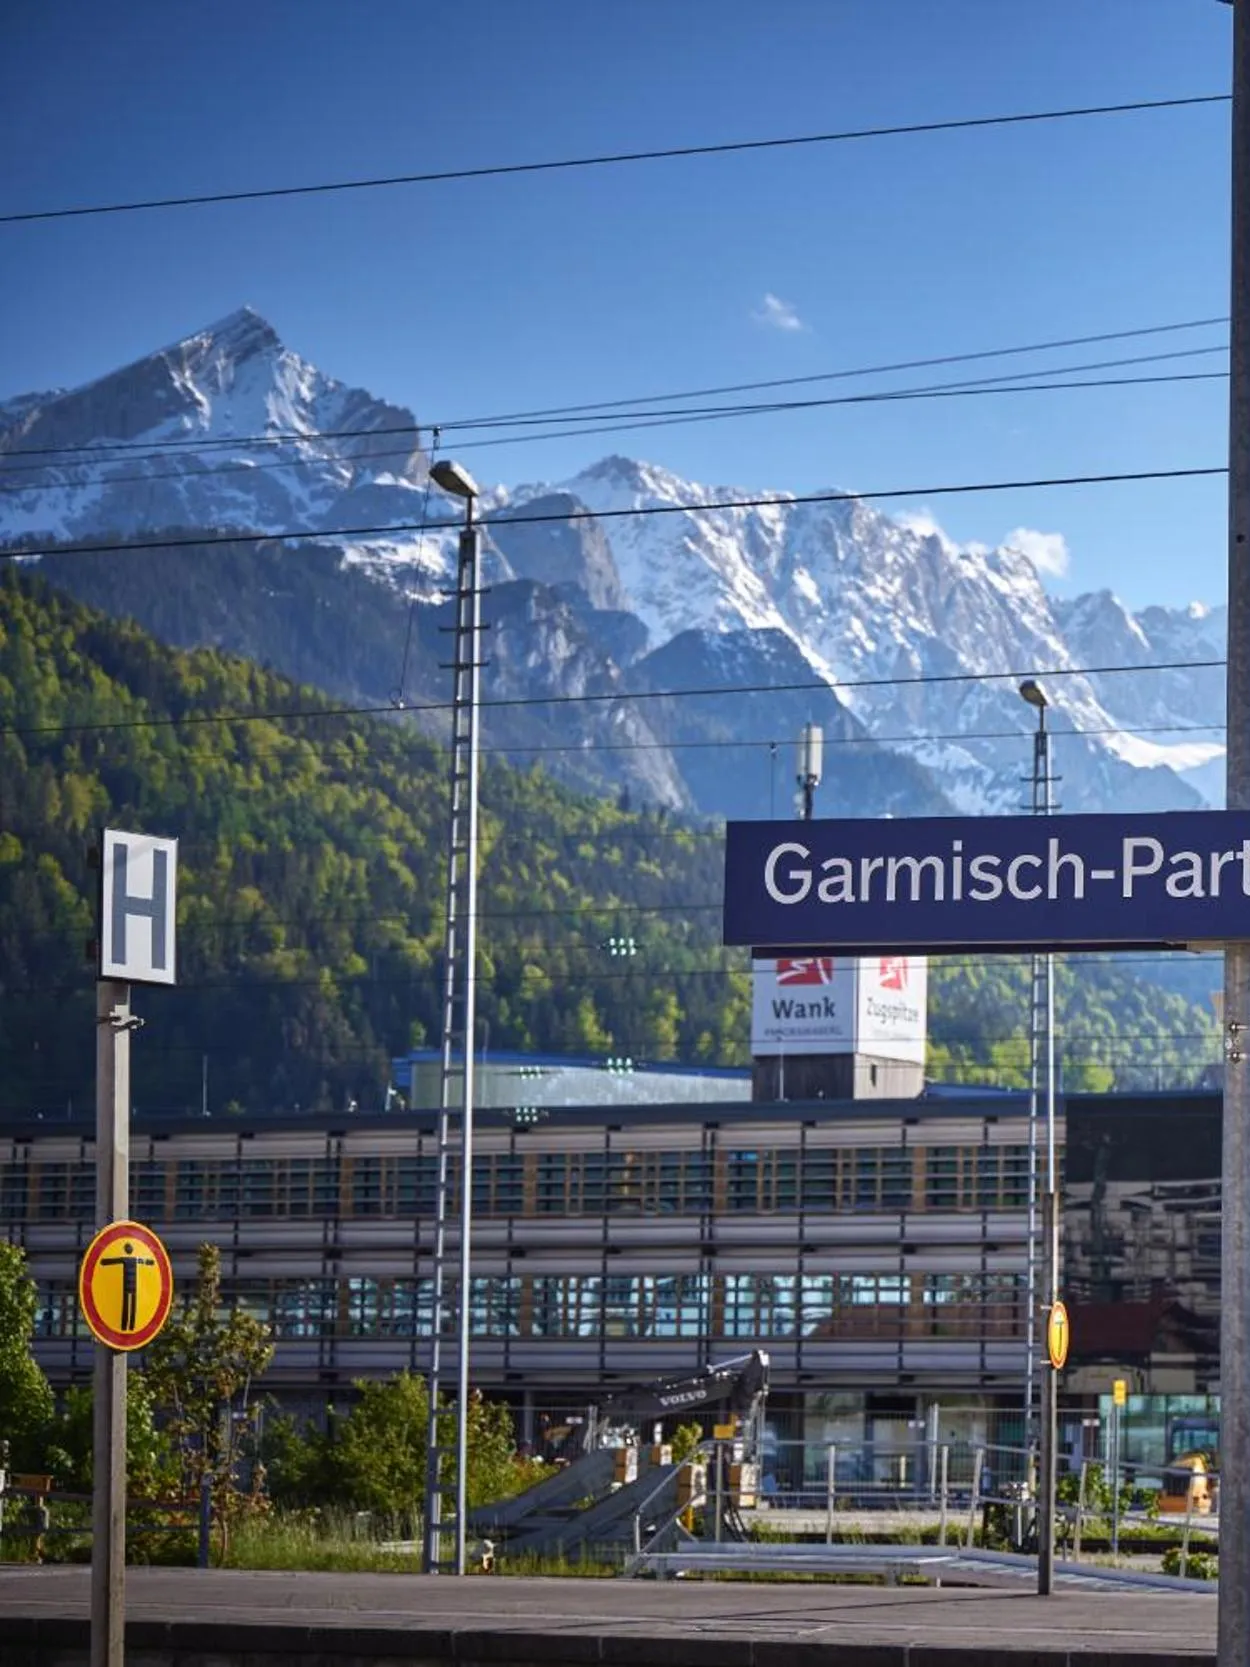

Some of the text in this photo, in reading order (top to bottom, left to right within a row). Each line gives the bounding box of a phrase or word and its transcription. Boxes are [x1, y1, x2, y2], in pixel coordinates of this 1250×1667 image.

[111, 842, 167, 971] H
[772, 996, 836, 1020] Wank
[660, 1389, 708, 1406] VOLVO
